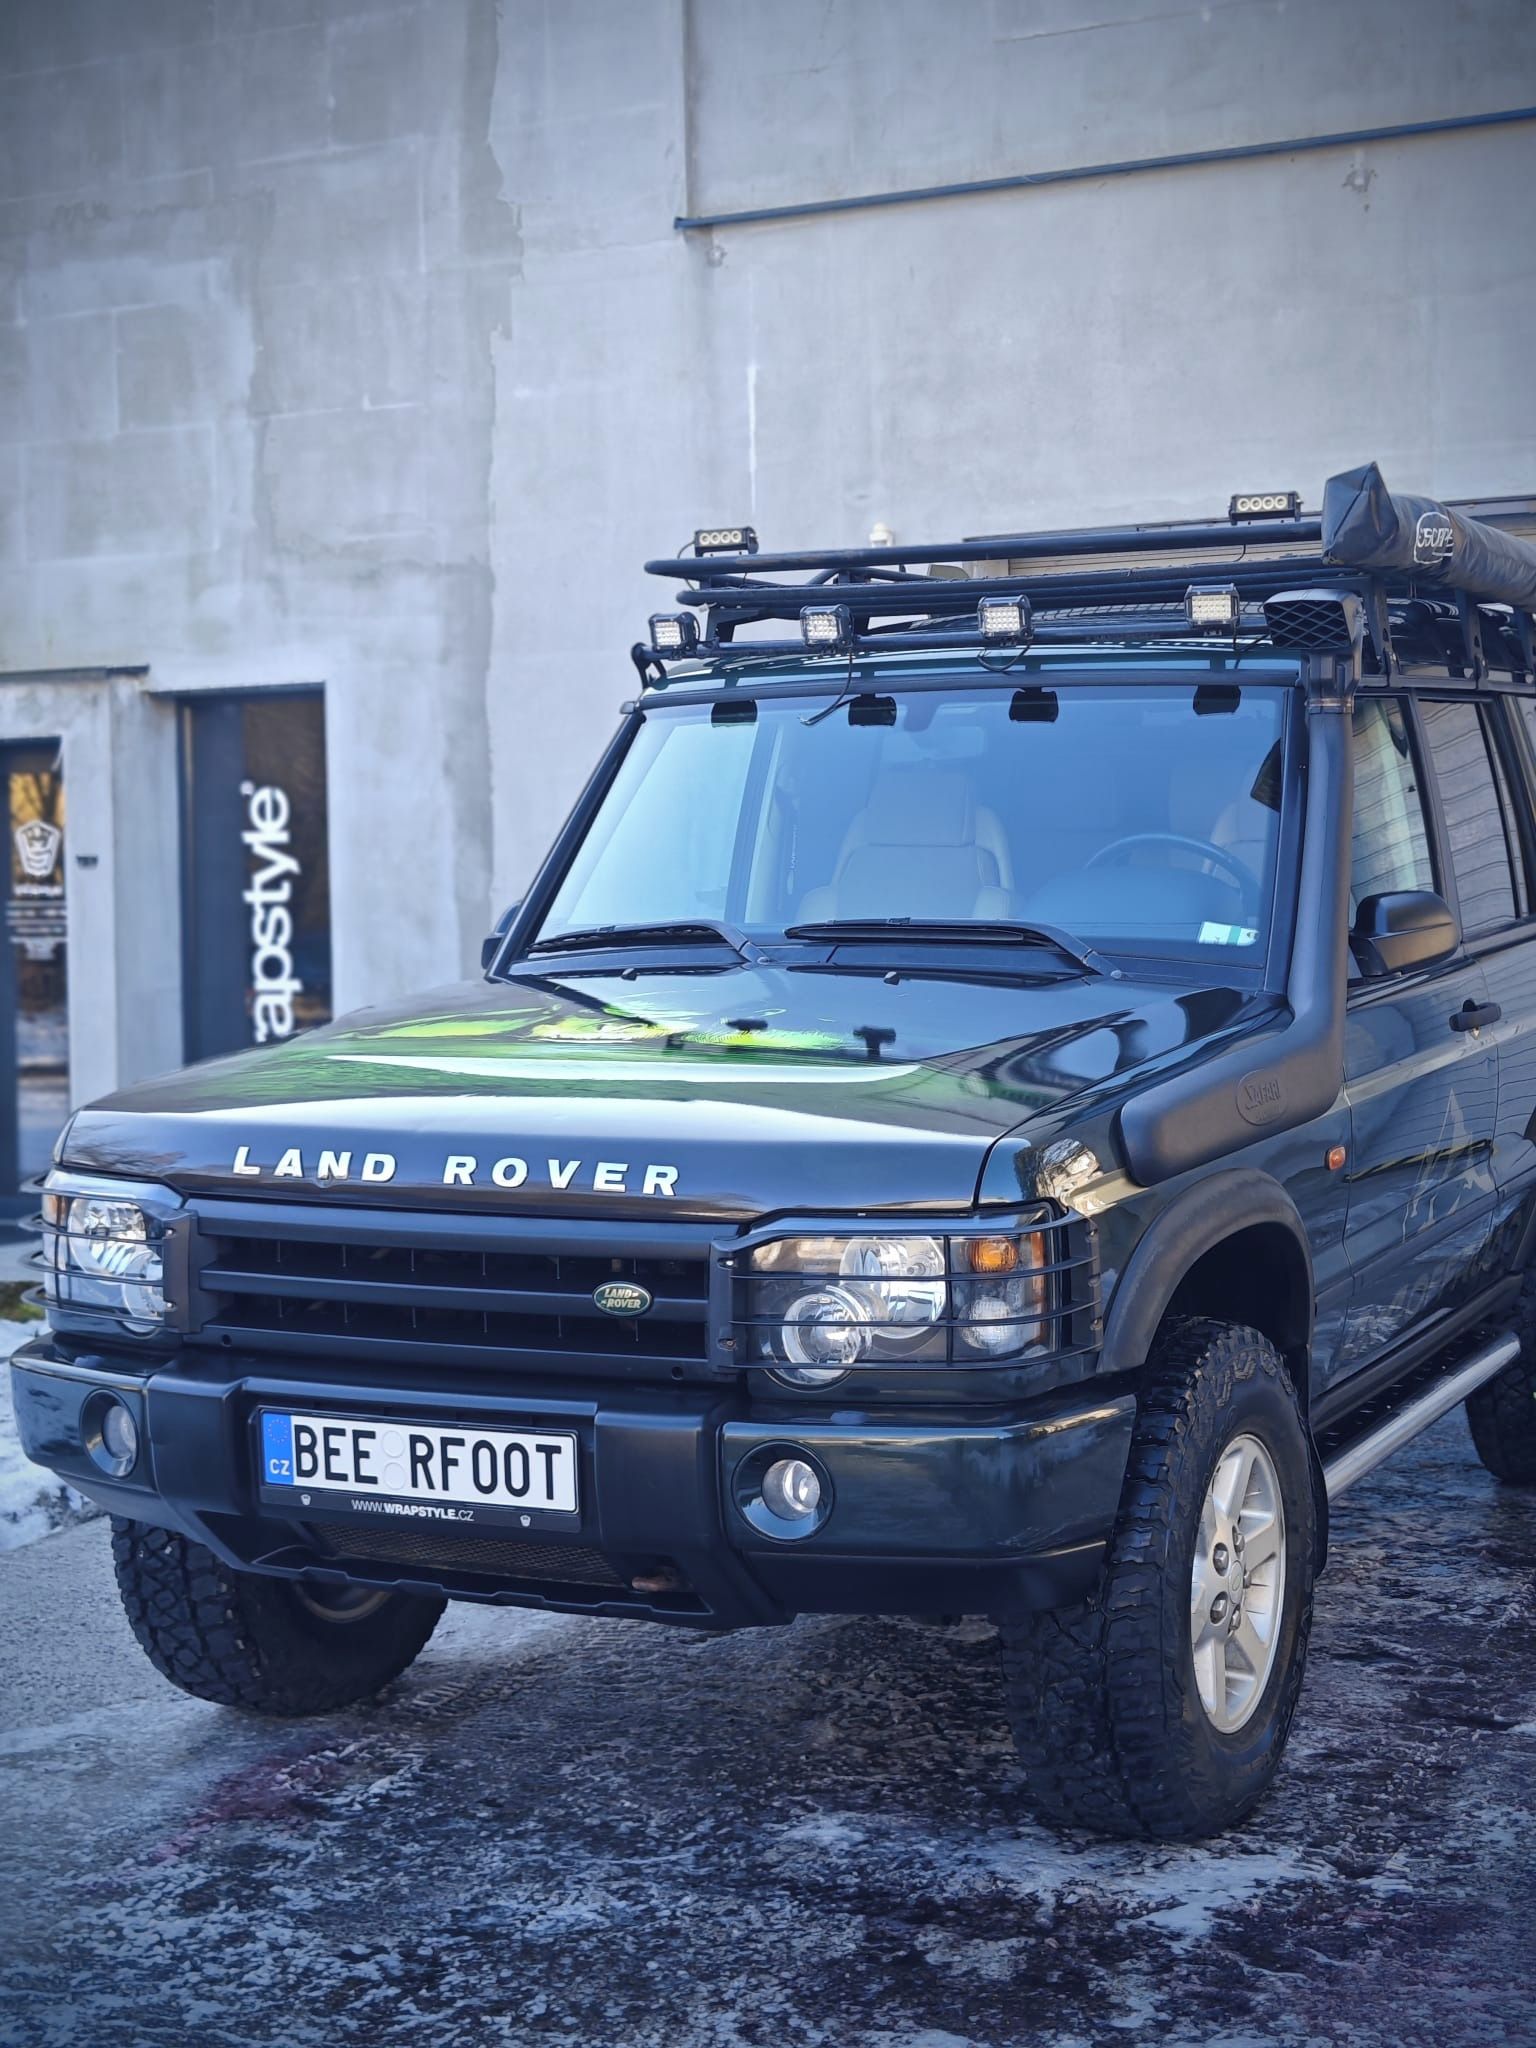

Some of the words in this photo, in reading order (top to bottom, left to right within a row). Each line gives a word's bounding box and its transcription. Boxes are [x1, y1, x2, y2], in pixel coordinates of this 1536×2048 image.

[241, 786, 303, 1043] apstyle
[232, 1146, 397, 1183] LAND
[442, 1155, 680, 1197] ROVER
[269, 1458, 291, 1476] CZ
[293, 1424, 379, 1485] BEE
[351, 1499, 475, 1522] WWW.WRAPSTYLE.CZ
